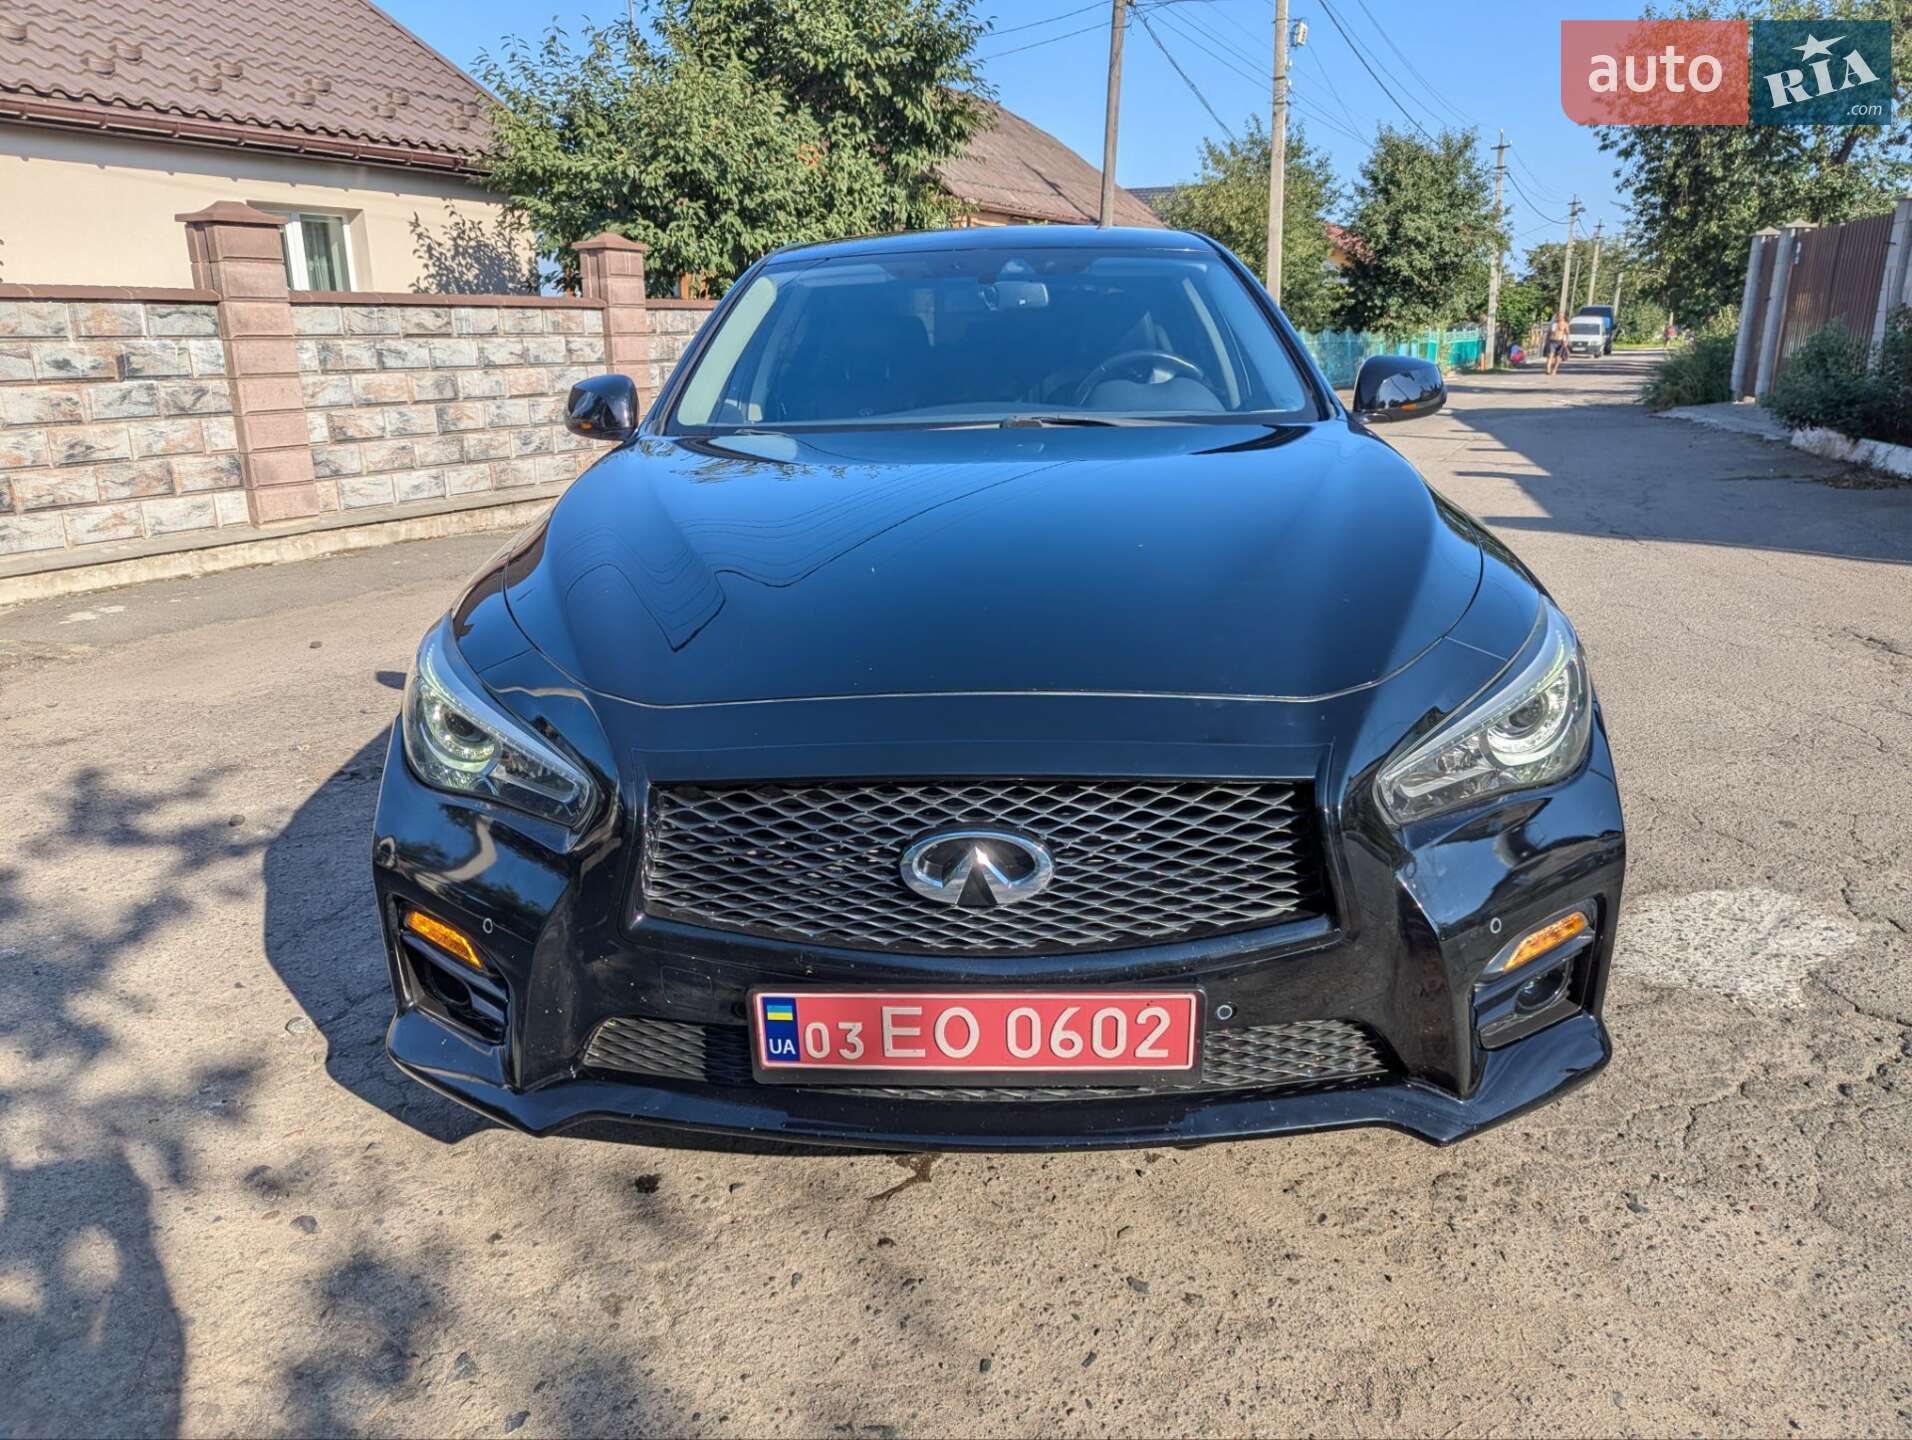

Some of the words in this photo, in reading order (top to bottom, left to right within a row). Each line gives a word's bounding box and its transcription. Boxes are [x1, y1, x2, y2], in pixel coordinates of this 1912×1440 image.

[768, 1037, 797, 1056] UA
[803, 1021, 865, 1060] 03
[881, 1005, 981, 1059] EO
[1005, 1005, 1172, 1060] 0602
